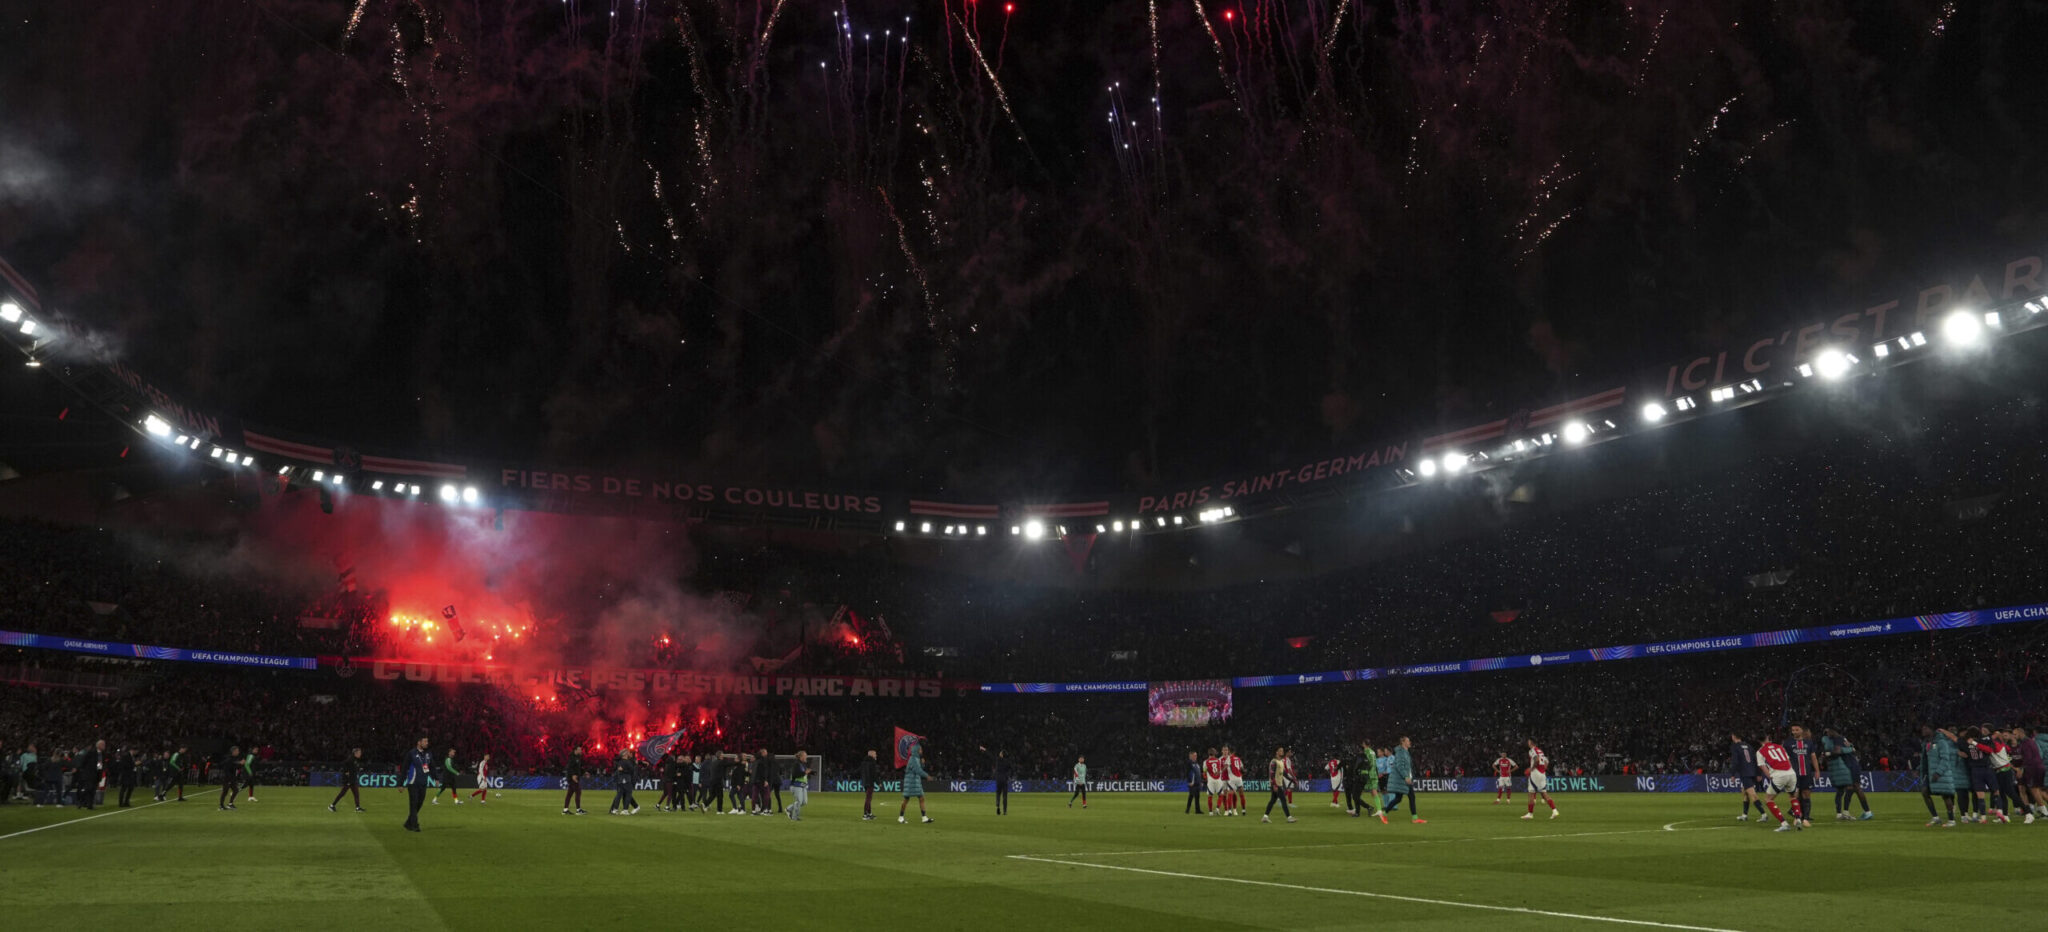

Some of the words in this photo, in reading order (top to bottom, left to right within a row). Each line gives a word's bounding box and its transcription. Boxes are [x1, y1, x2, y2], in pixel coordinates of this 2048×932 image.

[1663, 351, 1728, 399] ICI
[1742, 300, 1899, 374] C'EST
[1138, 486, 1212, 514] PARIS
[1220, 441, 1408, 499] SAINT-GERMAIN
[502, 469, 592, 492] FIERS
[602, 476, 642, 496] DE
[653, 481, 715, 502] NOS
[724, 487, 881, 513] COULEURS
[1994, 610, 2022, 620] UEFA
[1645, 645, 1665, 654] UEFA
[1666, 641, 1711, 652] CHAMPIONS
[1711, 638, 1742, 648] LEAGUE
[192, 652, 211, 660] UEFA
[213, 653, 259, 664] CHAMPIONS
[260, 657, 289, 666] LEAGUE
[1438, 663, 1461, 672] LEAGUE
[734, 676, 768, 695] AU
[774, 676, 842, 697] PARC
[847, 678, 942, 698] ARIS
[1083, 683, 1121, 691] CHAMPIONS
[1767, 747, 1790, 762] 41
[359, 774, 398, 787] GHTS
[634, 779, 660, 790] HAT
[883, 781, 901, 792] WE
[1096, 780, 1165, 792] #UCLFEELING
[1243, 780, 1259, 791] GHTS
[1260, 780, 1271, 791] WE
[1412, 779, 1458, 791] CLFEELING
[1545, 777, 1567, 791] HTS
[1569, 777, 1588, 791] WE
[1813, 776, 1832, 788] LEA
